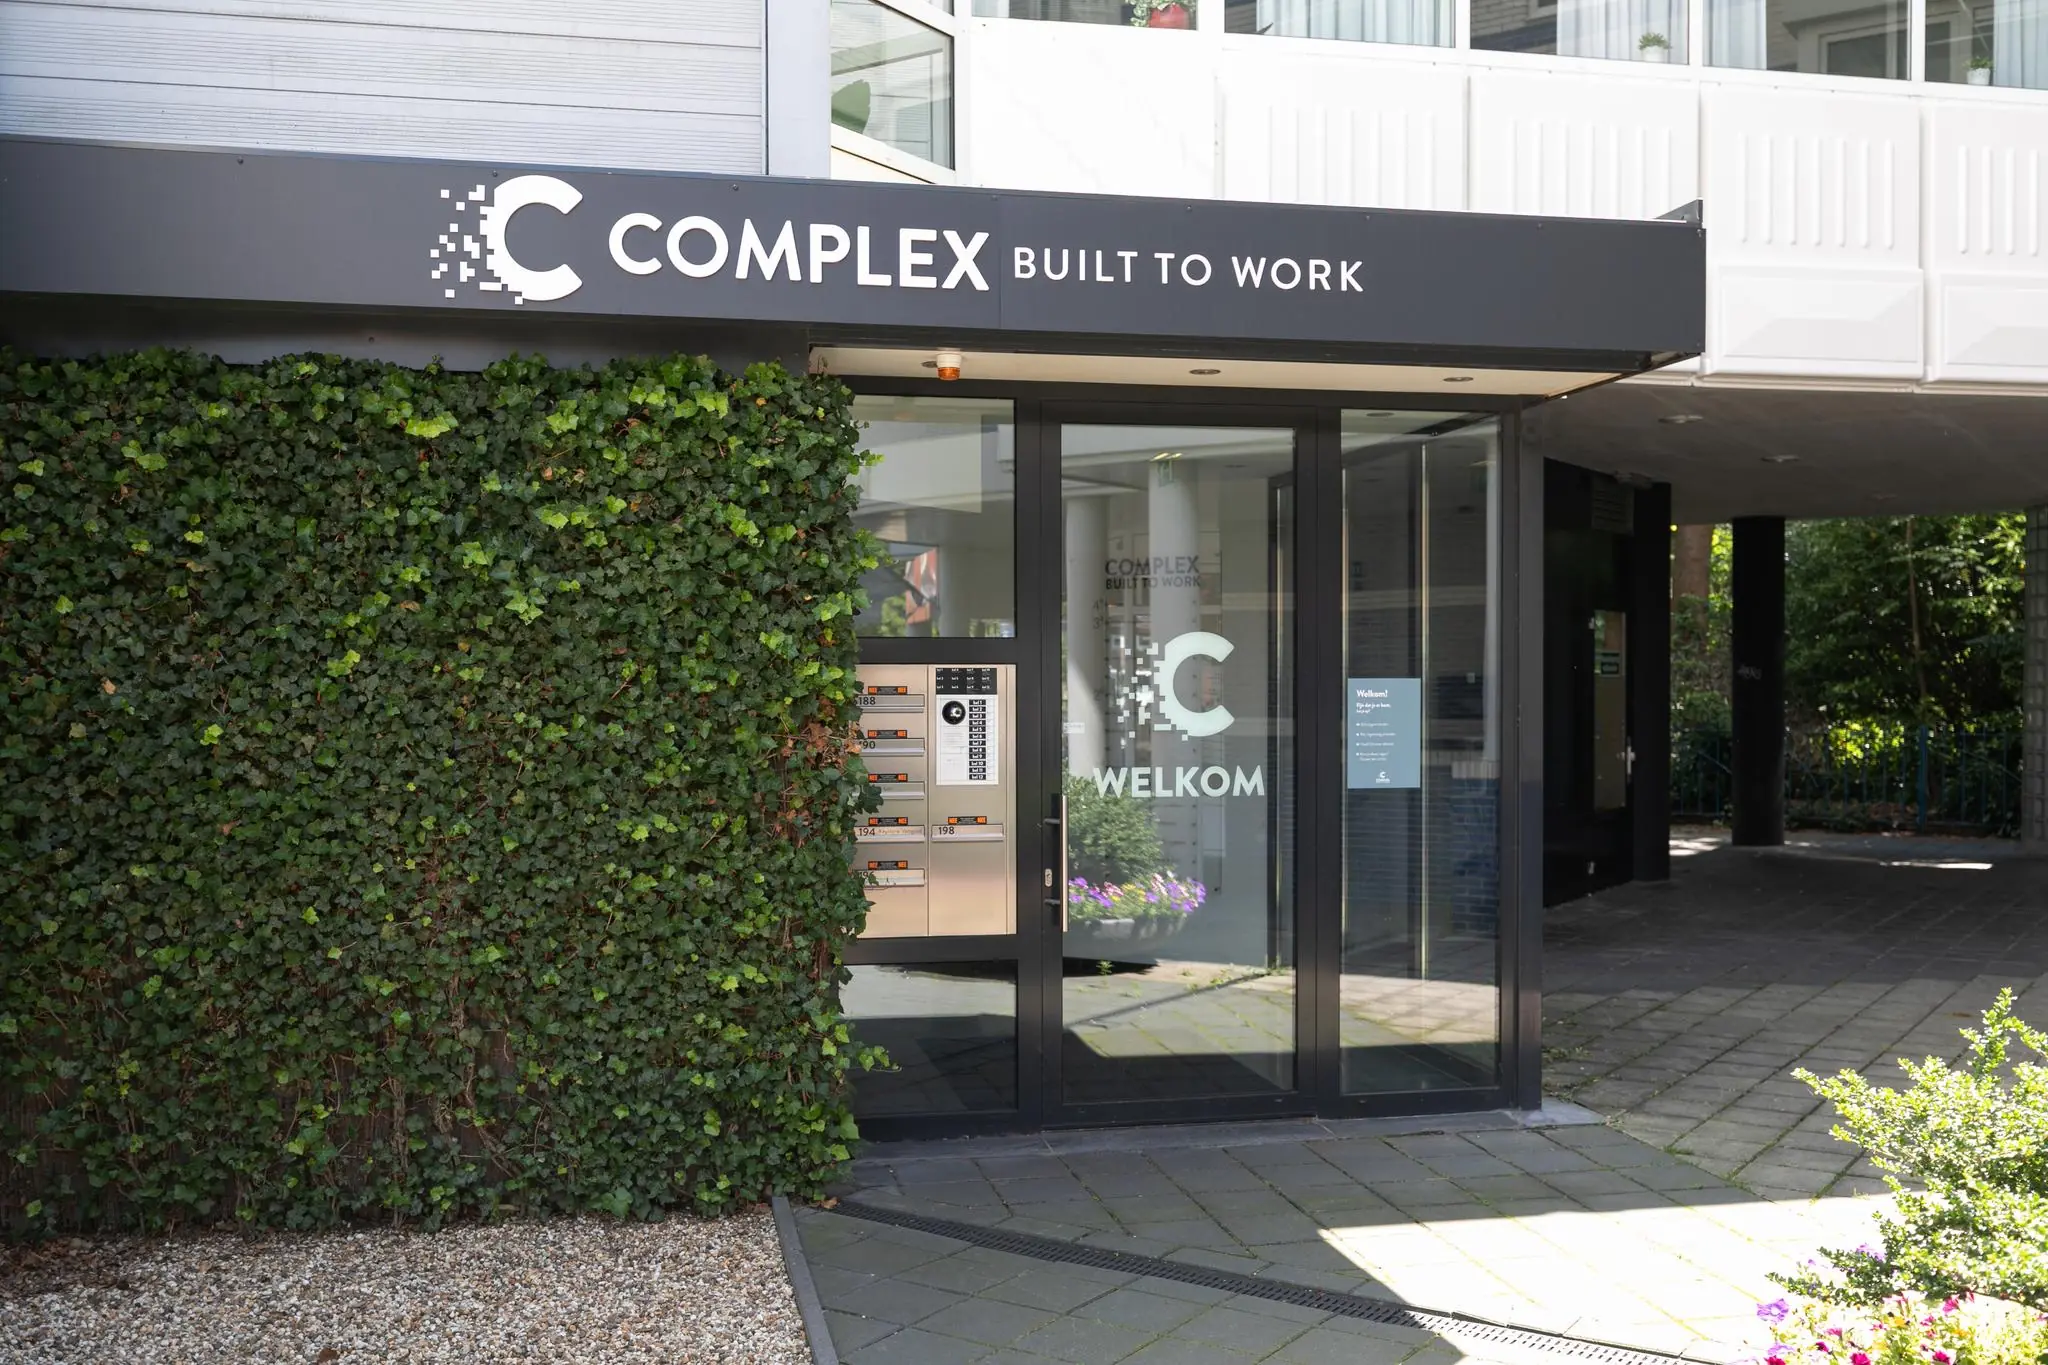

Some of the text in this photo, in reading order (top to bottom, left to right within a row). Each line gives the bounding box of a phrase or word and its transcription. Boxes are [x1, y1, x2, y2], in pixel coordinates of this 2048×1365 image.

[608, 212, 1364, 293] COMPLEX BUILT TO WORK
[1105, 556, 1200, 576] COMPLEX
[1106, 574, 1201, 590] BUILT TO WORK
[1356, 690, 1388, 698] Welkom!
[859, 697, 876, 705] 188
[1093, 765, 1265, 798] WELKOM
[859, 828, 875, 836] 194
[939, 826, 955, 834] 198
